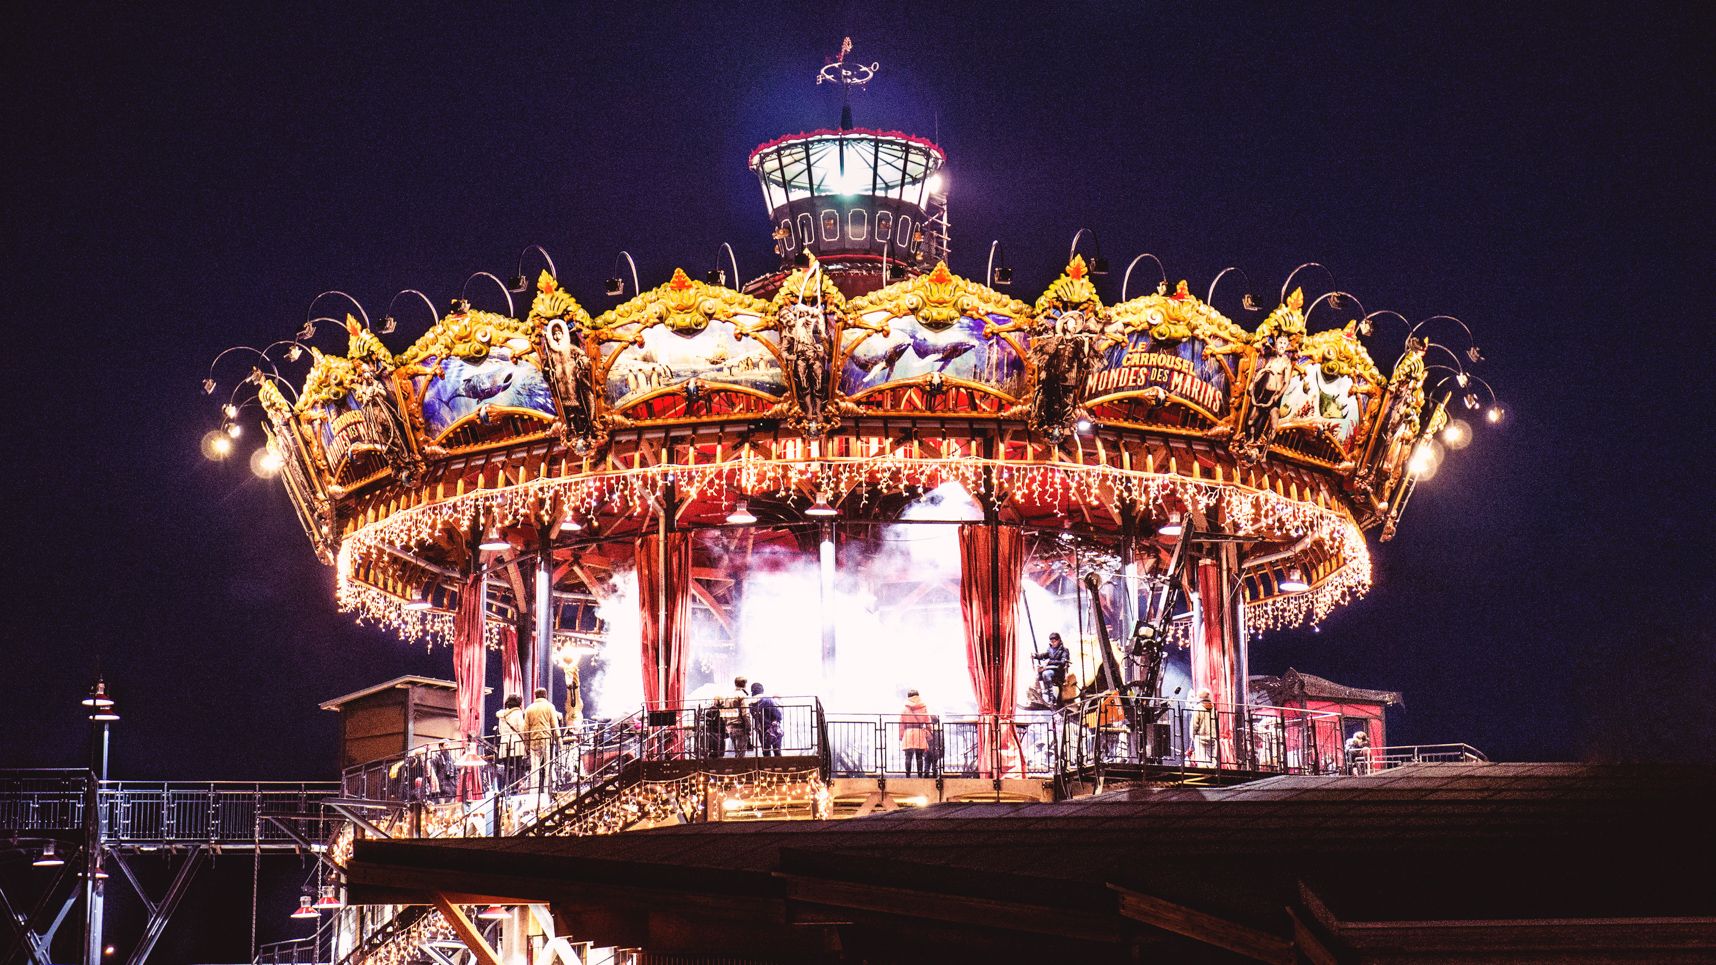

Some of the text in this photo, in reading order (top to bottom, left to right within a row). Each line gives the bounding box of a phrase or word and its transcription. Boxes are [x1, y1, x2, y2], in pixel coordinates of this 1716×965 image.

[1128, 341, 1146, 353] LE
[1122, 353, 1197, 377] CARROUSEL
[1085, 367, 1223, 413] MONDES DES MARINS
